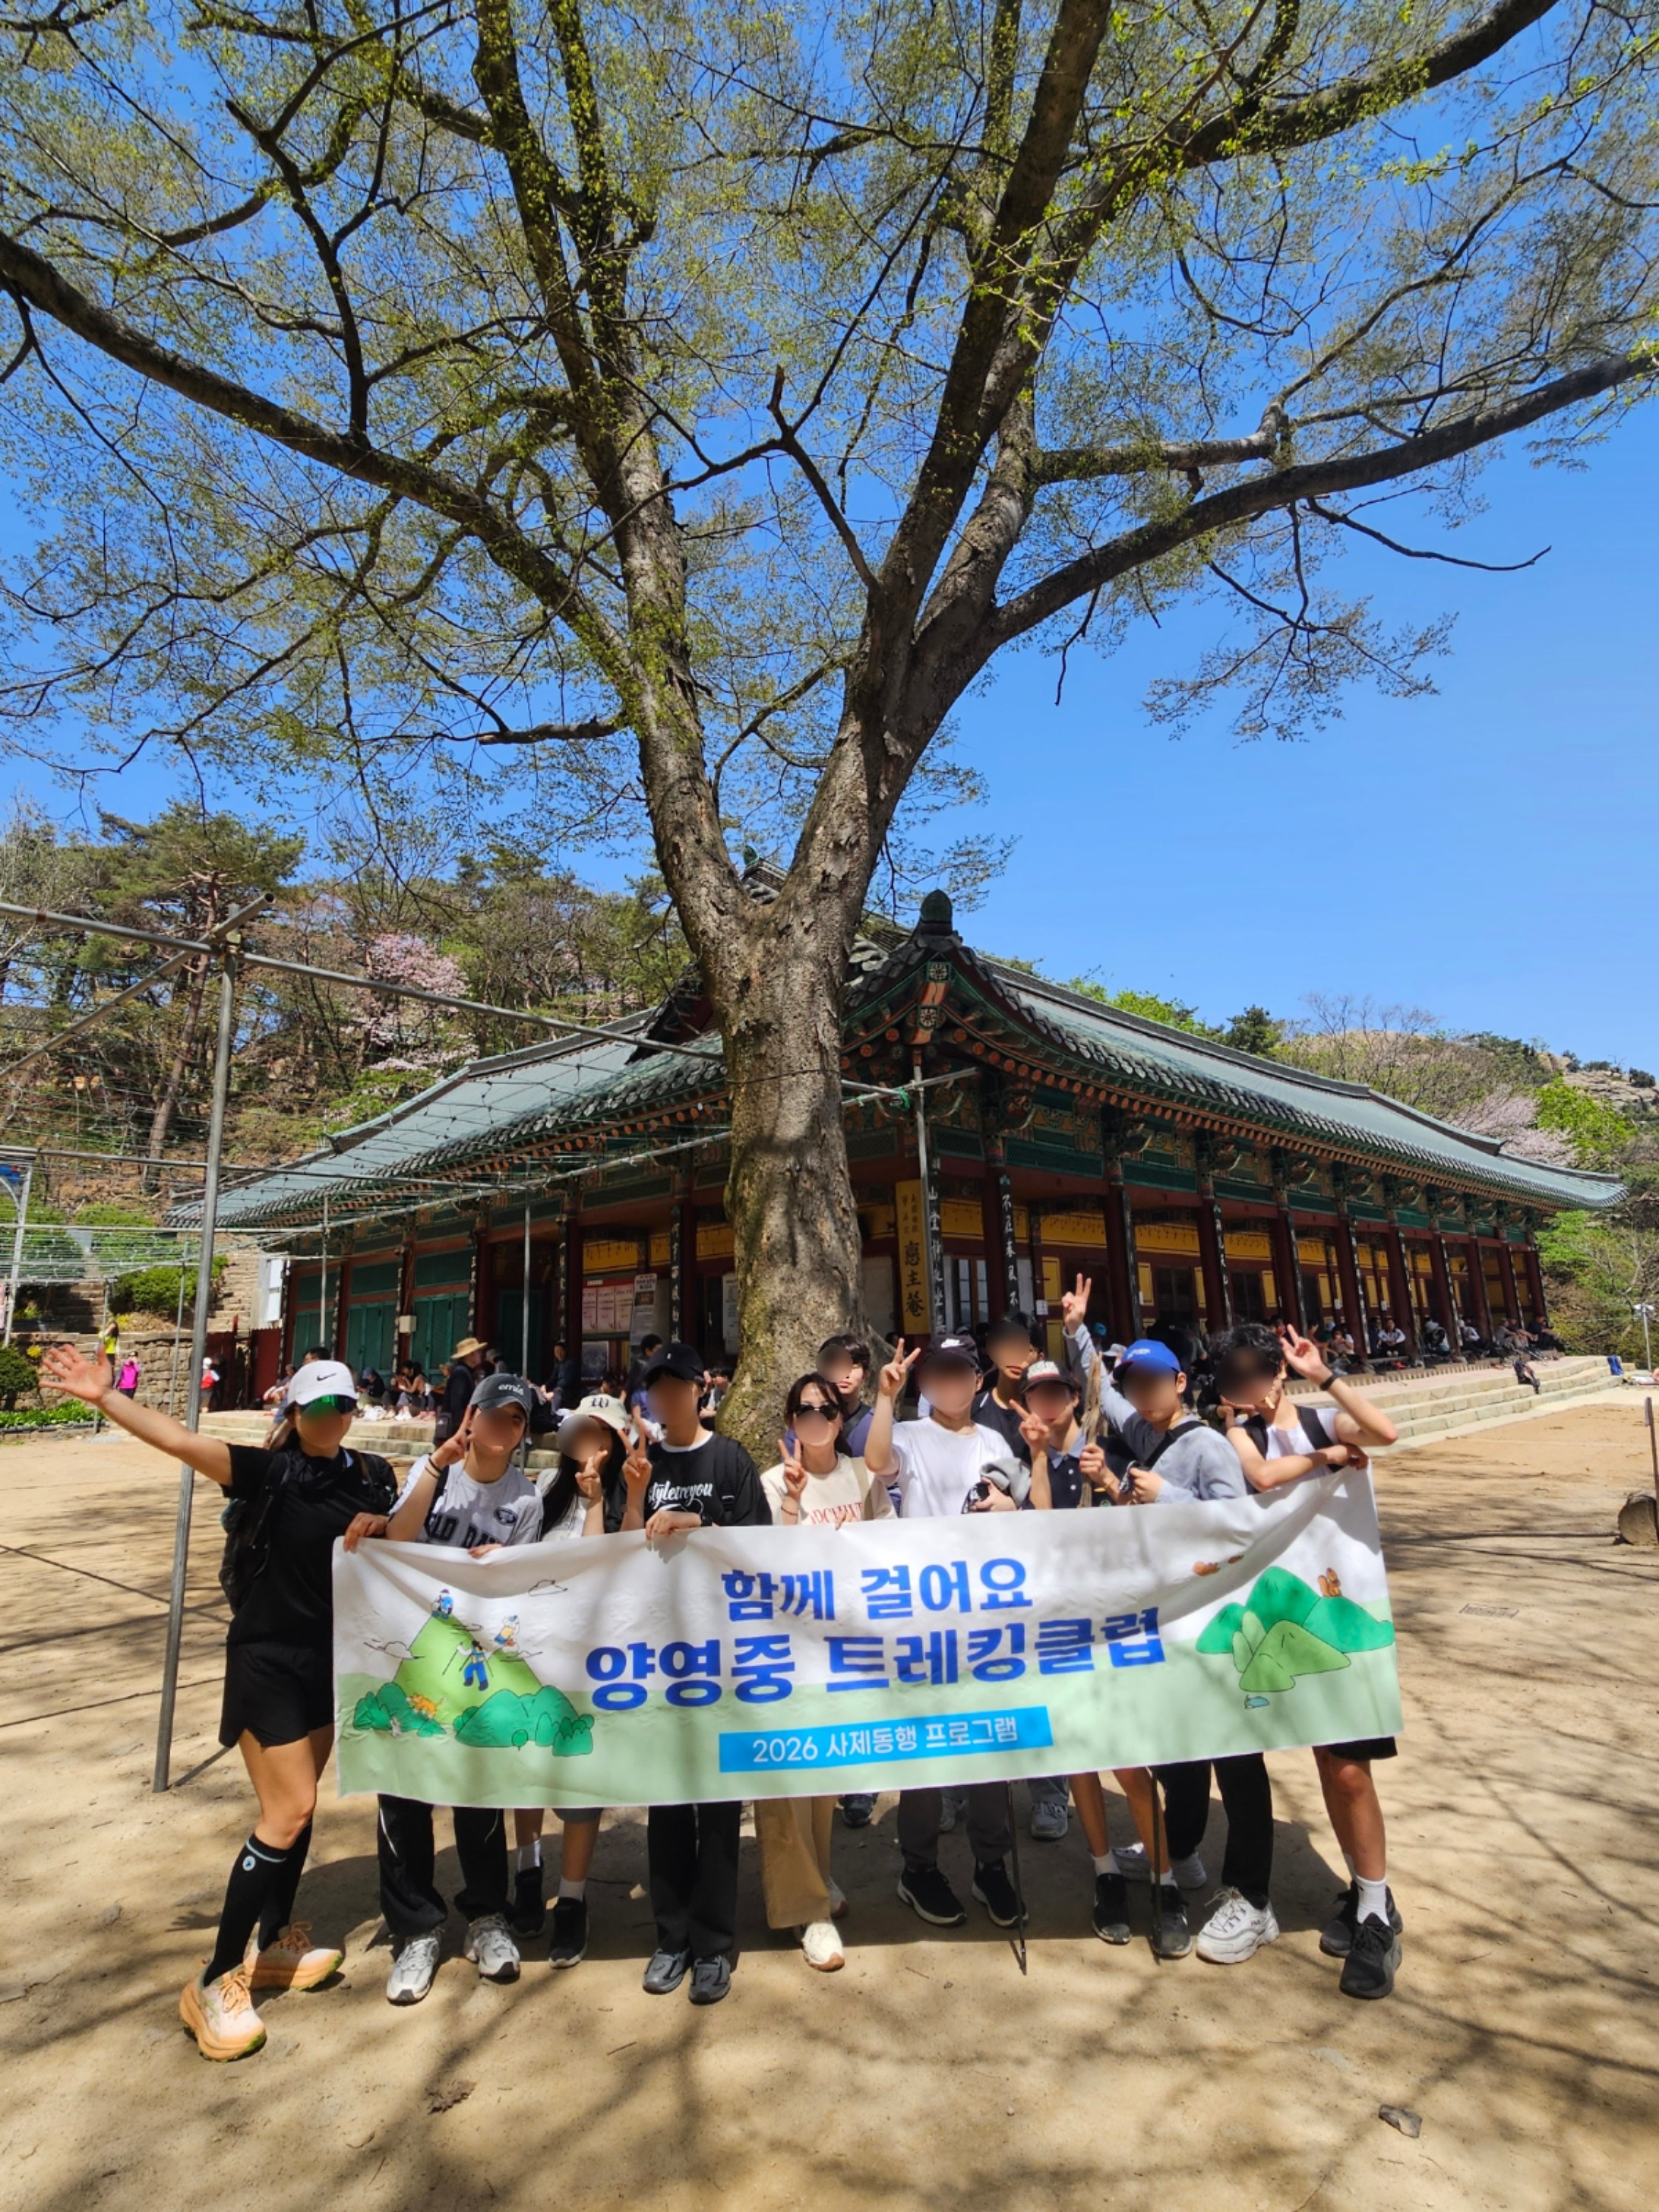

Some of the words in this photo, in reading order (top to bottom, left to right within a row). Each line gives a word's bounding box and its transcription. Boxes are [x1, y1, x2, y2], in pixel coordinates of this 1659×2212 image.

[722, 1571, 836, 1622] 함께
[860, 1557, 1033, 1621] 걸어요
[585, 1634, 796, 1711] 양영중
[825, 1607, 1165, 1692] 트레킹클럽
[752, 1736, 818, 1763] 2026
[826, 1724, 918, 1759] 사제동행
[925, 1716, 1018, 1749] 프로그램
